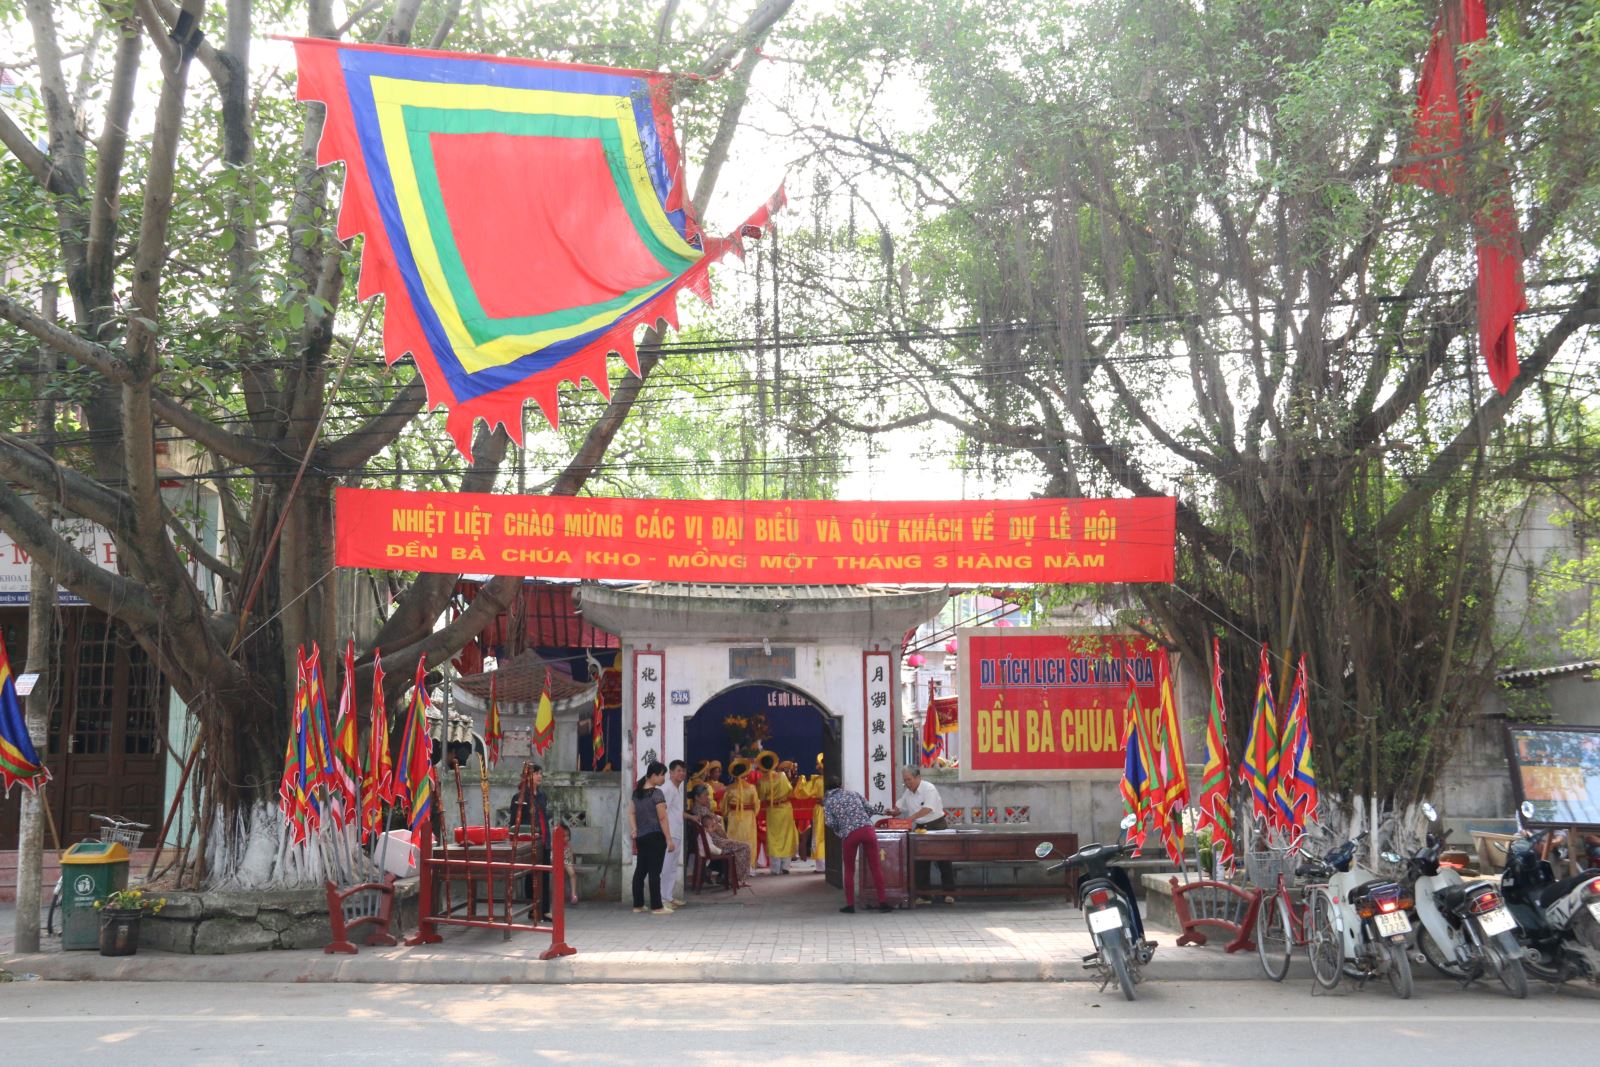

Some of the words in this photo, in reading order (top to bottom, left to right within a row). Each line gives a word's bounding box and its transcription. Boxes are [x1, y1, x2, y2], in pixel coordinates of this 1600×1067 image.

[392, 503, 446, 538] NHIỆT
[454, 505, 492, 541] LIỆT
[504, 508, 554, 537] CHÀO
[564, 508, 623, 538] MỪNG
[636, 508, 675, 539] CÁC
[684, 515, 703, 545] VỊ
[712, 516, 744, 546] ĐẠI
[755, 507, 799, 542] BIỂU
[816, 515, 841, 542] VÀ
[898, 512, 963, 543] KHÁCH
[1009, 515, 1037, 547] DỰ
[1049, 506, 1072, 539] LỄ
[1084, 509, 1116, 546] HỘI
[386, 541, 437, 558] ĐỀN
[451, 545, 486, 560] BÀ
[501, 547, 573, 563] CHÚA
[585, 551, 640, 567] KHO
[668, 548, 747, 568] MỒNG
[760, 553, 818, 572] MỘT
[833, 553, 922, 570] THÁNG
[933, 555, 948, 568] 3
[957, 553, 1032, 569] HÀNG
[1044, 552, 1104, 568] NĂM
[980, 658, 995, 684] DI
[998, 652, 1030, 684] TÍCH
[1034, 658, 1066, 690] LỊCH
[977, 694, 1020, 752] ĐỀN
[1026, 700, 1055, 752] BÀ
[1060, 700, 1118, 752] CHÚA
